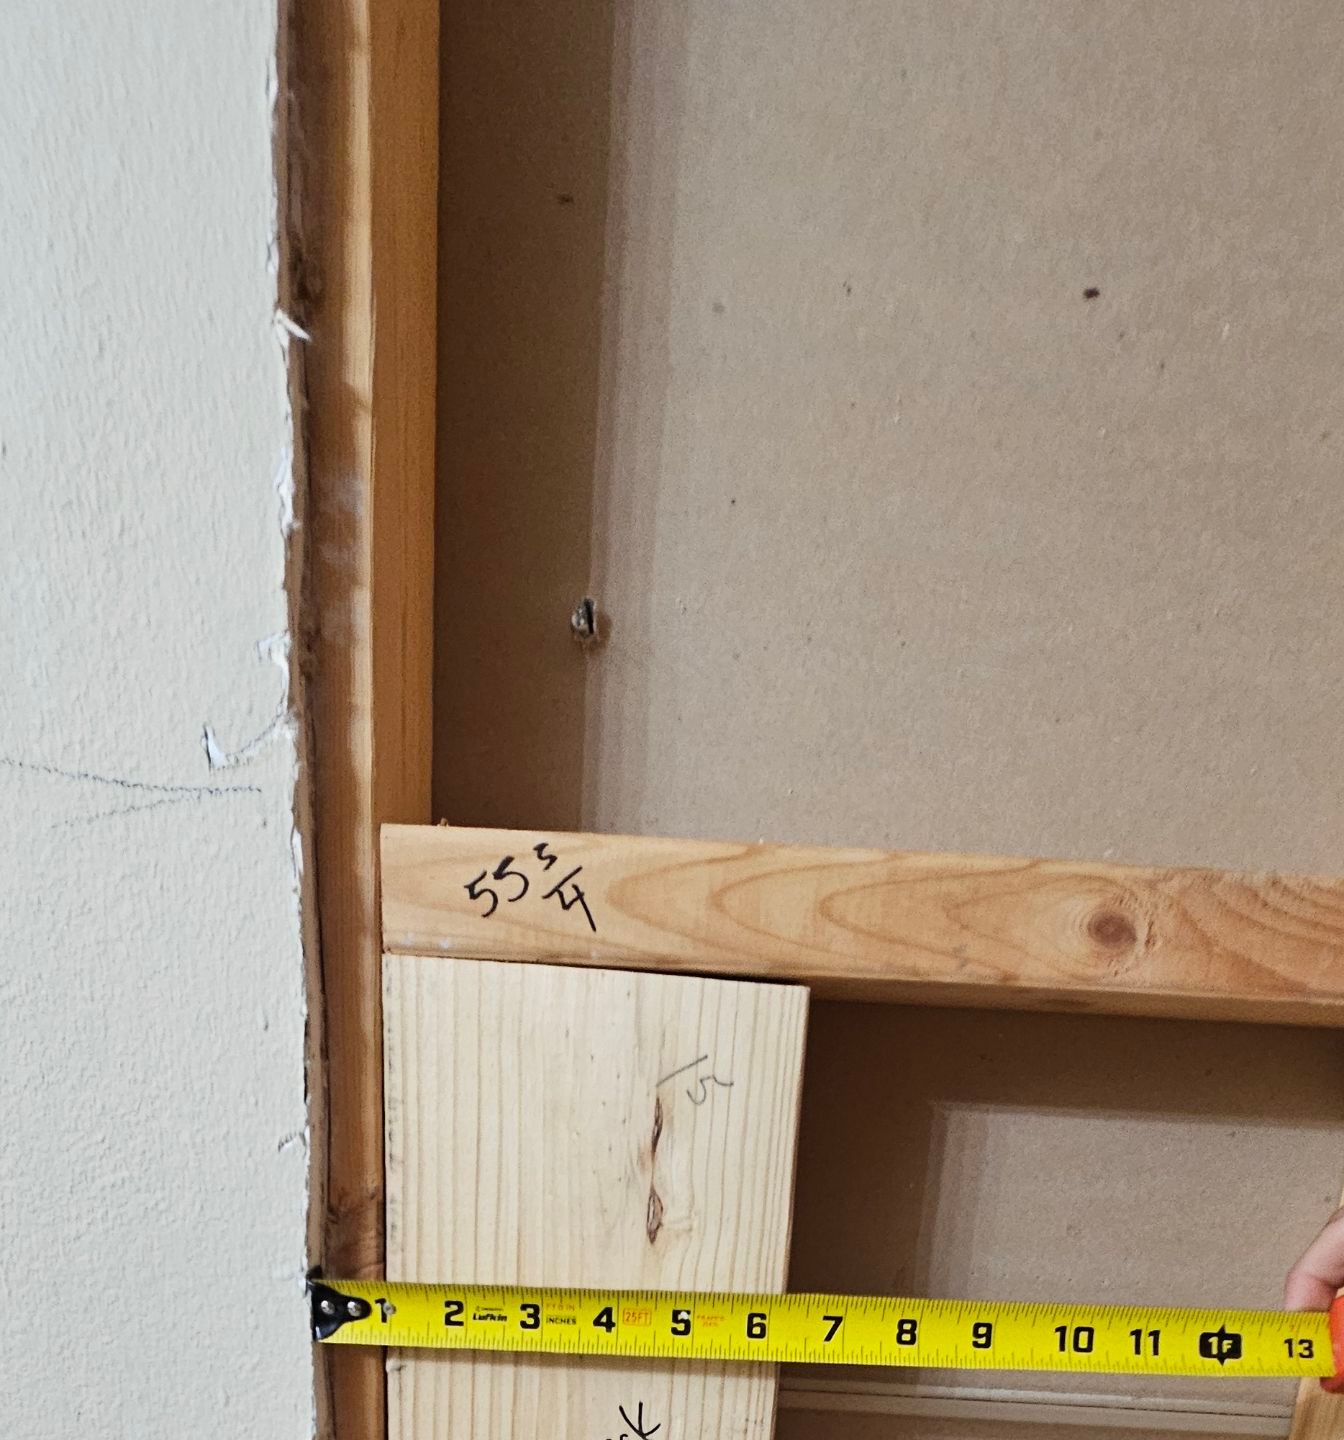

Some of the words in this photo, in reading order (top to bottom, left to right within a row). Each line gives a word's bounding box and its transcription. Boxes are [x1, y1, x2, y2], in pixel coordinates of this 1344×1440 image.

[463, 856, 529, 918] 55
[374, 1297, 388, 1324] 1
[444, 1300, 465, 1327] 2
[472, 1312, 508, 1322] Lufkin
[519, 1303, 541, 1330] 3
[546, 1315, 577, 1326] INCHES
[592, 1306, 617, 1333] 4
[670, 1309, 692, 1336] 5
[746, 1312, 767, 1339] 6
[822, 1315, 844, 1342] 7
[895, 1318, 918, 1346] 8
[971, 1322, 993, 1349] 9
[1054, 1325, 1095, 1353] 10
[1129, 1328, 1161, 1356] 11
[1207, 1336, 1233, 1355] 1F
[1283, 1338, 1315, 1359] 13
